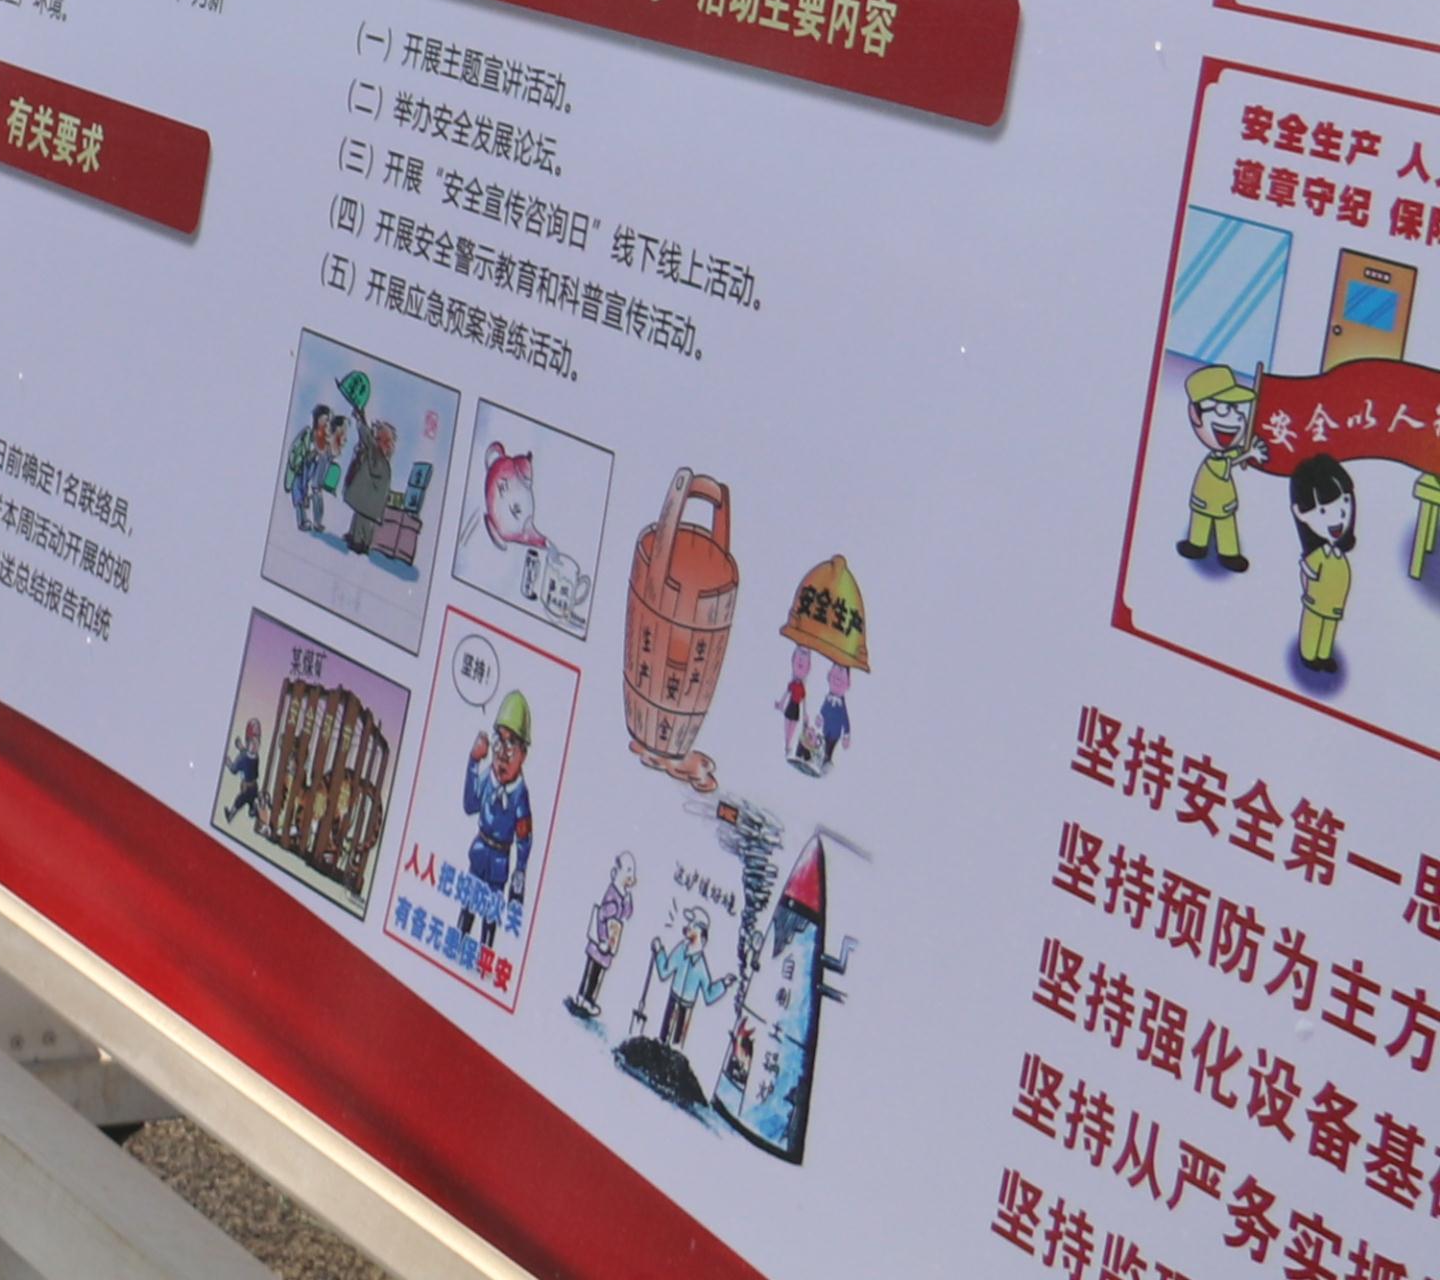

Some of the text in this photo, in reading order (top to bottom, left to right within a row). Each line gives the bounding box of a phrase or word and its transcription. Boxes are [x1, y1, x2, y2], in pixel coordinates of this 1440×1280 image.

[1230, 157, 1373, 229] 遵章守纪
[795, 584, 864, 637] 安全生产
[1031, 936, 1440, 1220] 坚持强化设备基
